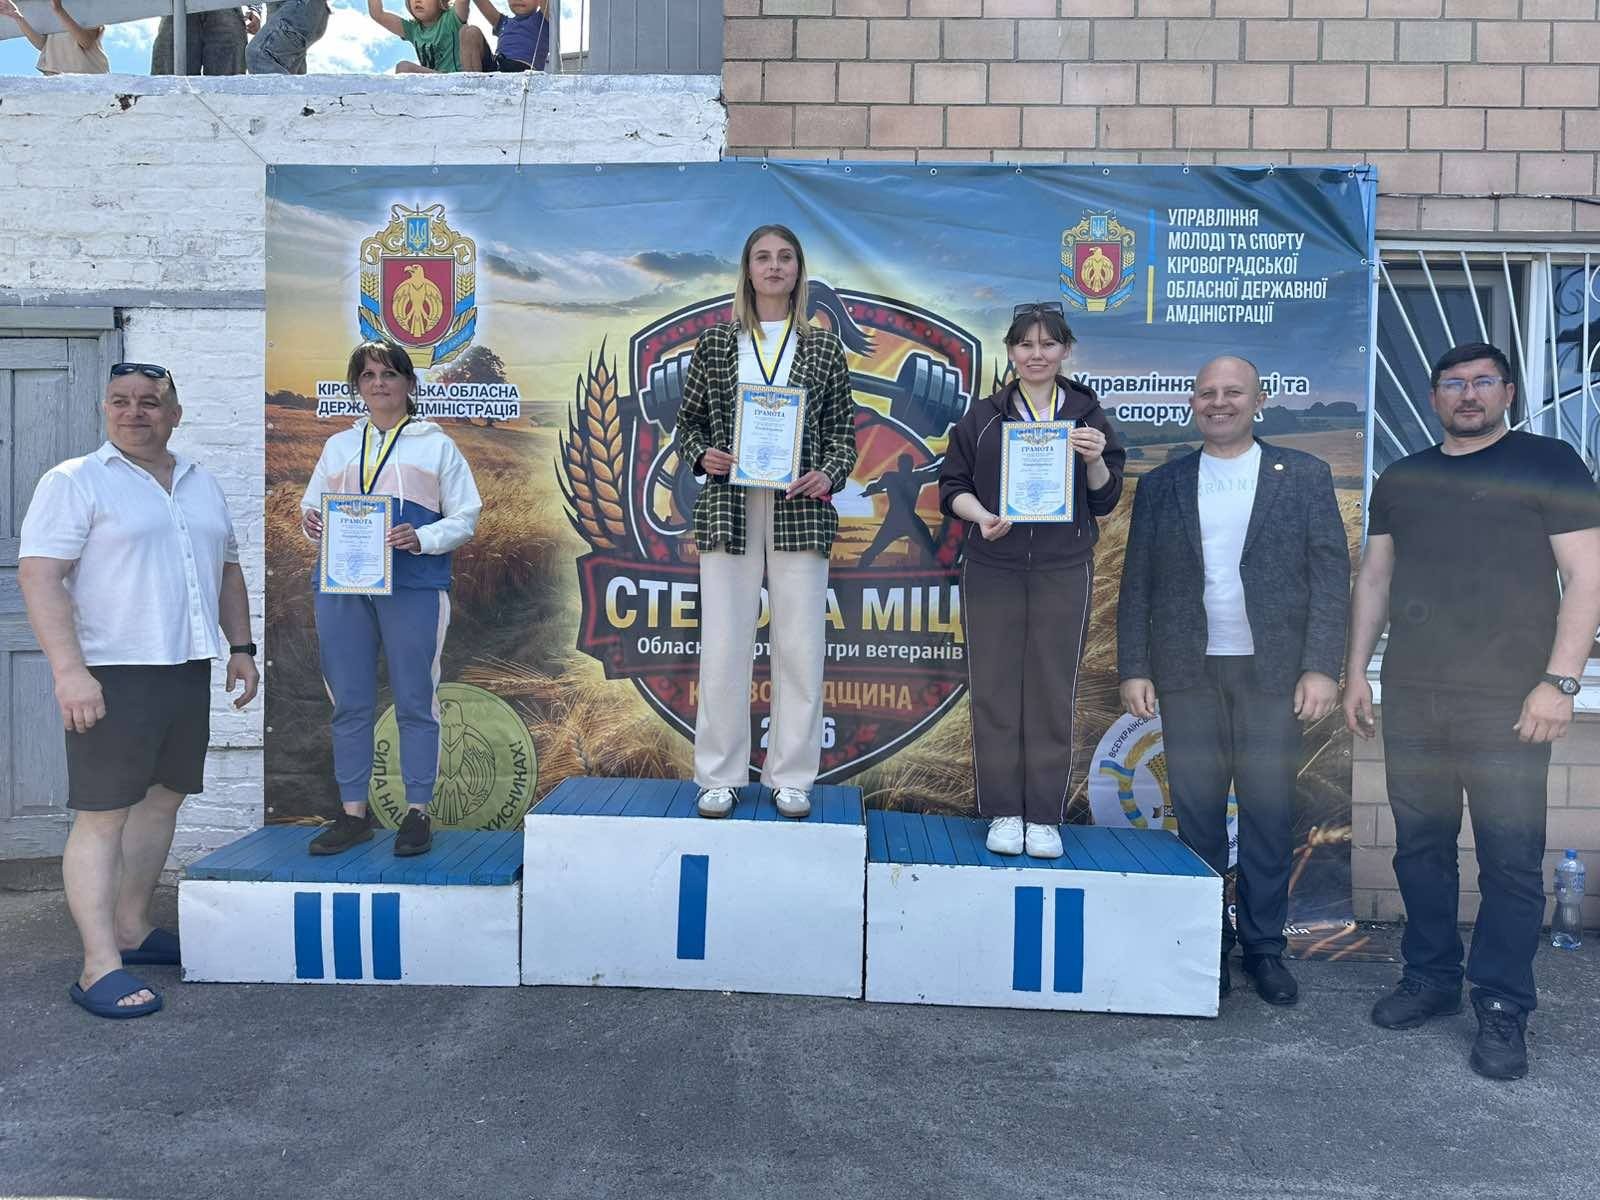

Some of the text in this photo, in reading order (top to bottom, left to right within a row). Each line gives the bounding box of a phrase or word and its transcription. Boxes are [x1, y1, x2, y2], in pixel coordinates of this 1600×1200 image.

[1168, 208, 1259, 227] УПРАВЛІННЯ
[1168, 232, 1304, 251] МОЛОДІ ТА СПОРТУ
[1168, 253, 1299, 276] КІРОВОГРАДСЬКОЇ
[1167, 277, 1328, 301] ОБЛАСНОЇ ДЕРЖАВНОЇ
[1166, 302, 1275, 324] АМДІНІСТРАЦІЇ
[450, 385, 518, 399] ОБЛАСНА
[1284, 378, 1307, 393] та
[319, 401, 519, 418] ДЕРЖА ДМІНІСТРАЦІЯ
[754, 409, 785, 418] ГРАМОТА
[1119, 405, 1192, 424] спорту
[1021, 445, 1055, 453] ГРАМОТА
[866, 642, 963, 662] ветеранів
[373, 739, 391, 790] СИЛА
